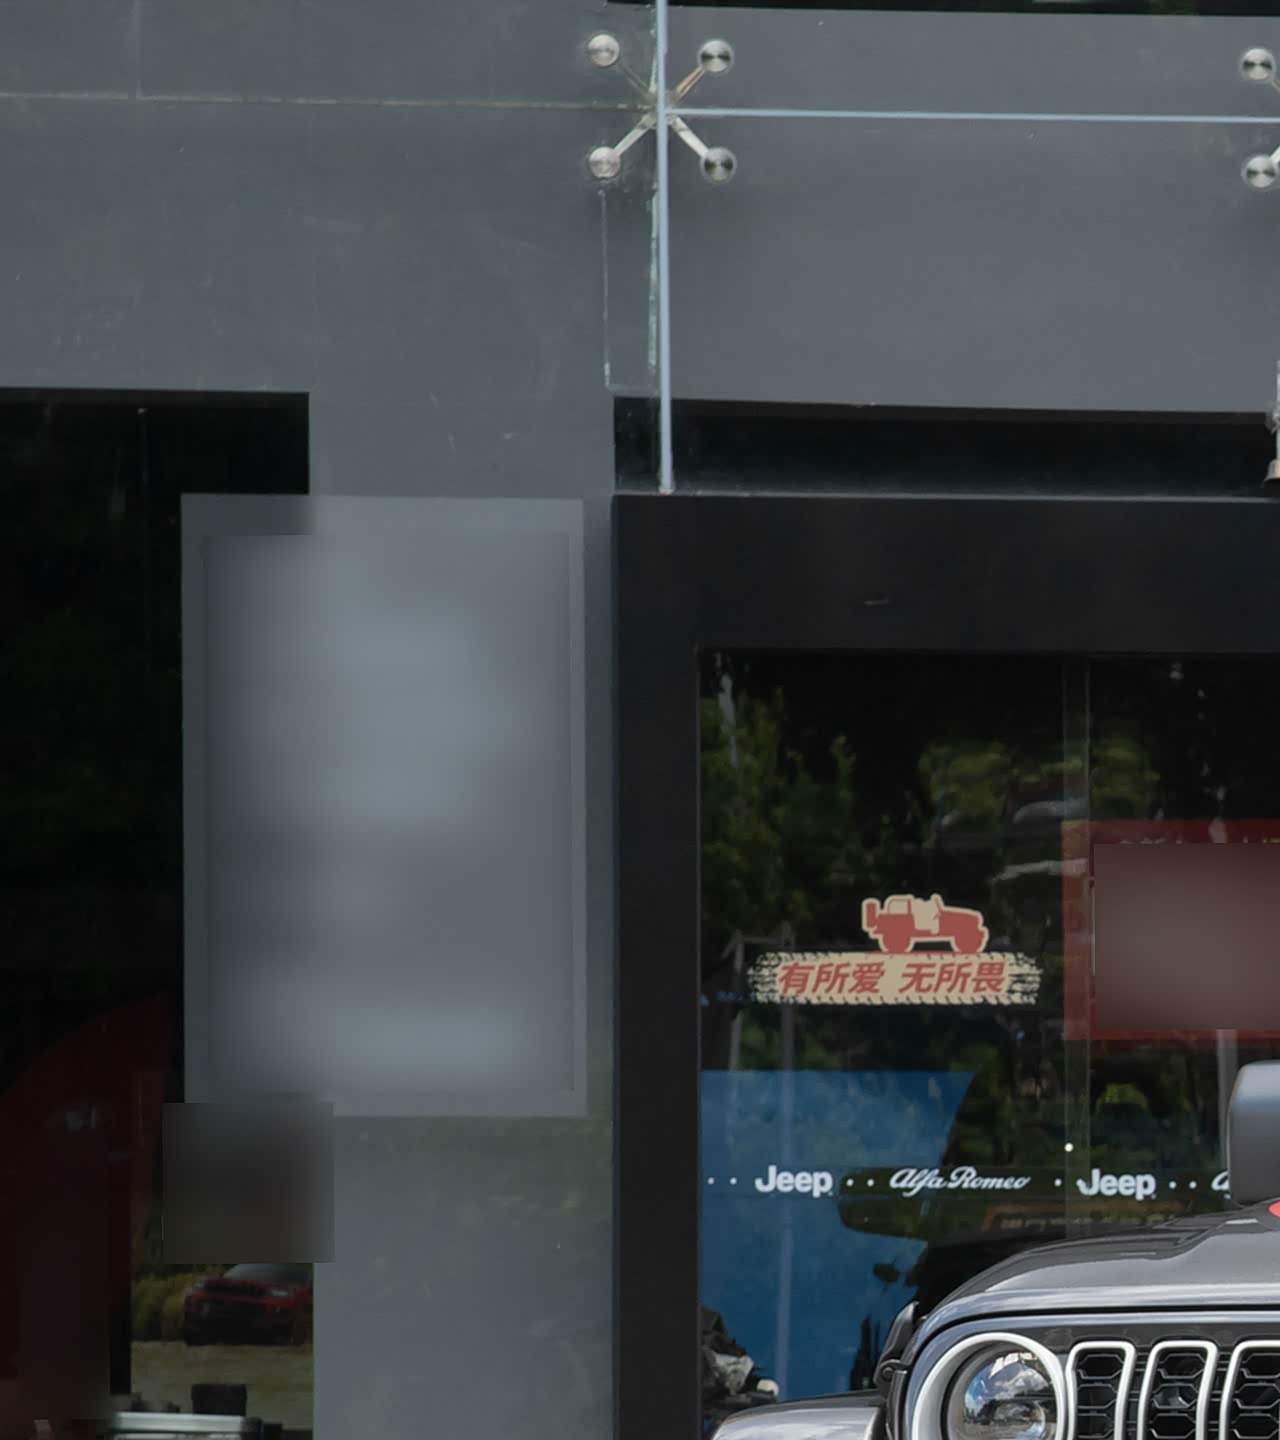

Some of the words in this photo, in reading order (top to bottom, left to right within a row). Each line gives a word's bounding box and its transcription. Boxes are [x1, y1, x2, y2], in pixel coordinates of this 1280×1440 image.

[778, 960, 885, 995] 有所爱
[898, 960, 1005, 994] 无所畏
[754, 1165, 833, 1199] Jeep
[889, 1167, 948, 1198] Alfa
[949, 1165, 1031, 1190] Romeo
[1077, 1168, 1156, 1200] Jeep
